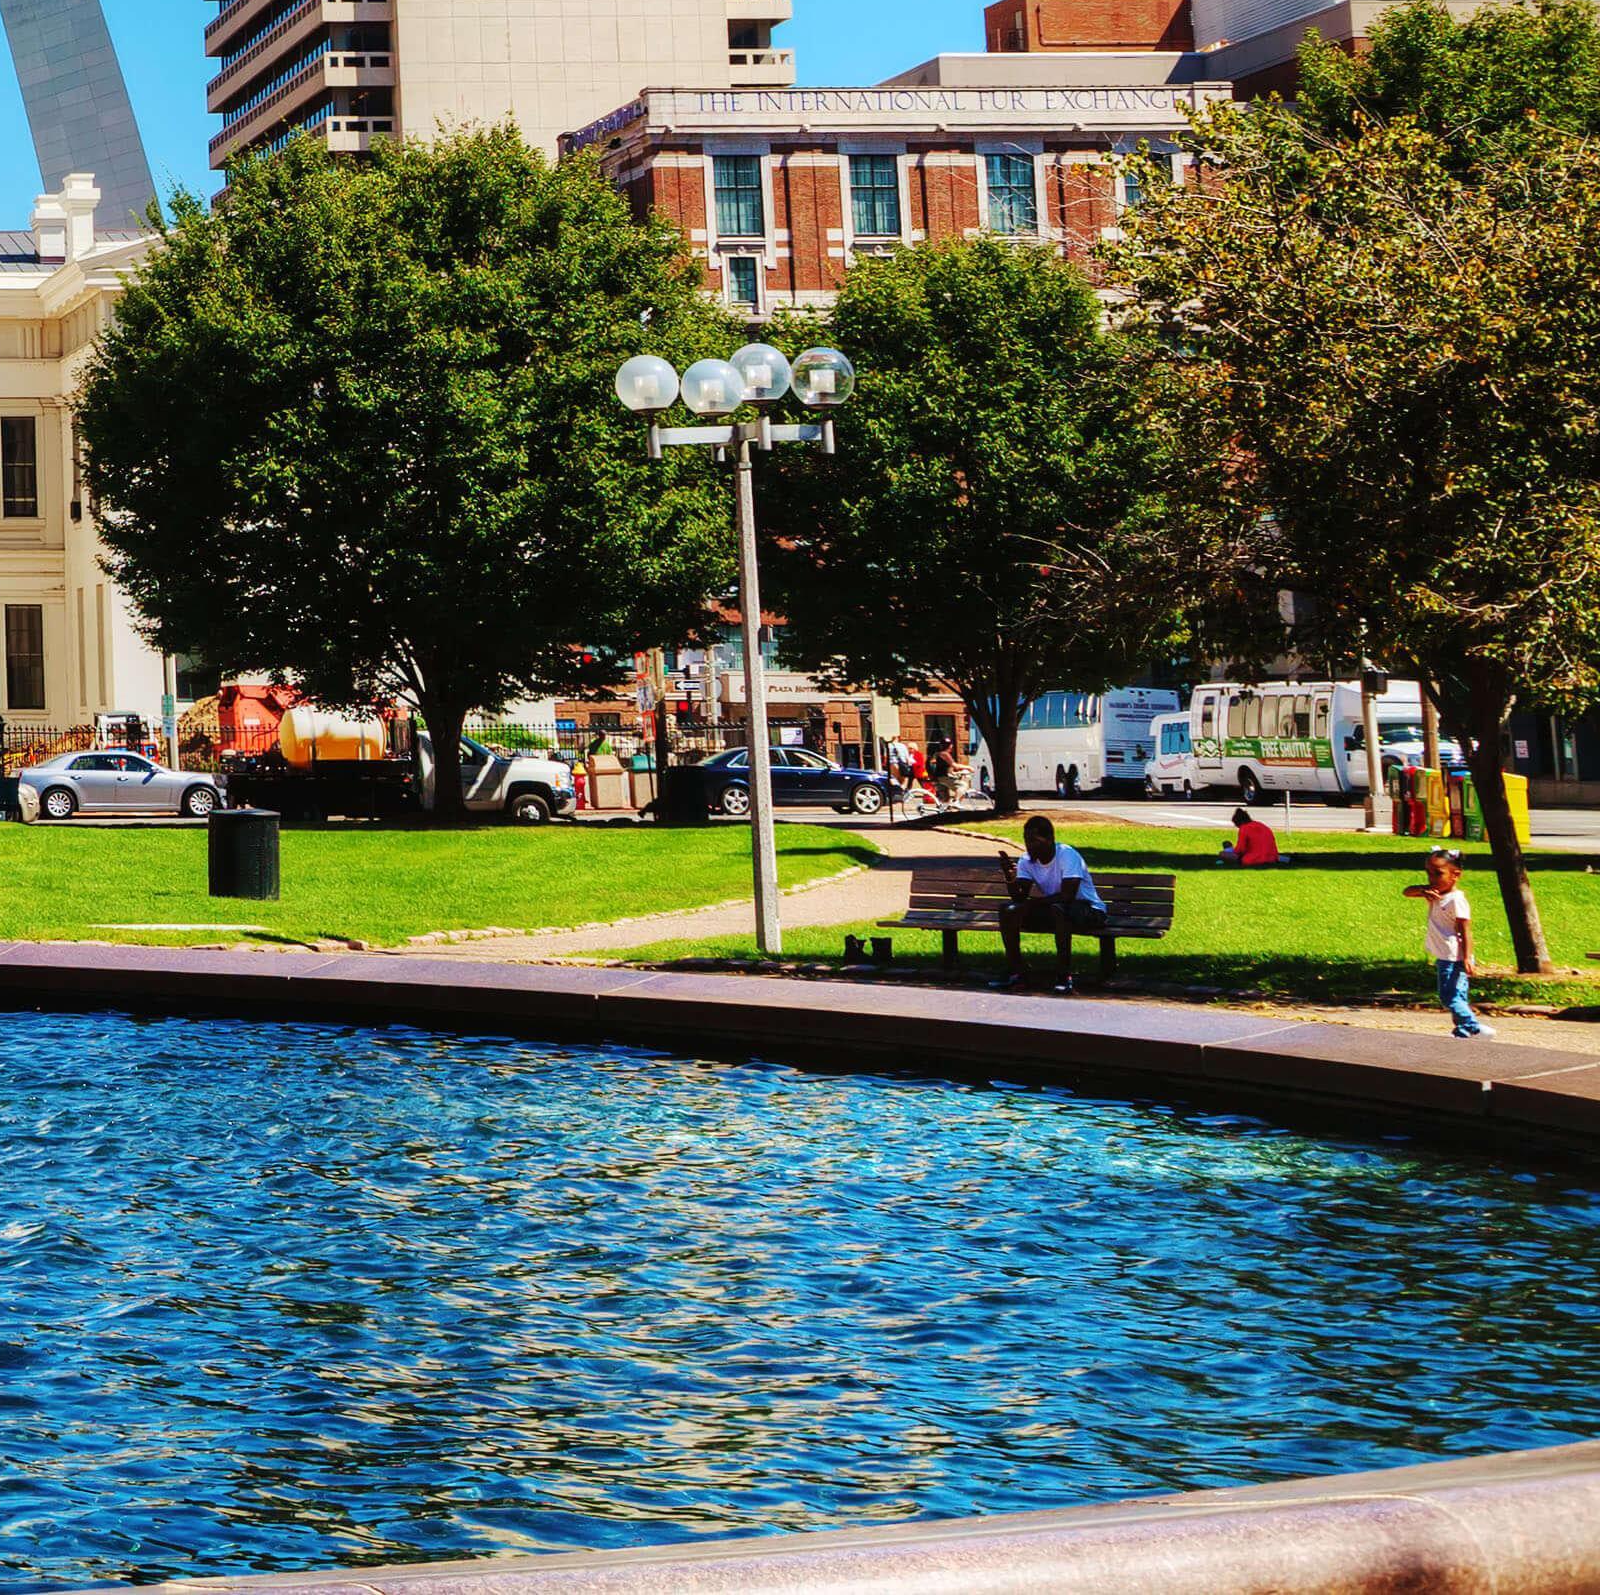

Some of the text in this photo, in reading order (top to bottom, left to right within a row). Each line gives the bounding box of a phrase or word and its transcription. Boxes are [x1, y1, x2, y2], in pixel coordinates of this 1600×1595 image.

[698, 91, 743, 112] THE
[757, 90, 965, 112] INTERNATIONAL
[978, 90, 1028, 110] FUR
[1261, 741, 1279, 758] FREE
[1279, 741, 1312, 758] SHUTTLE
